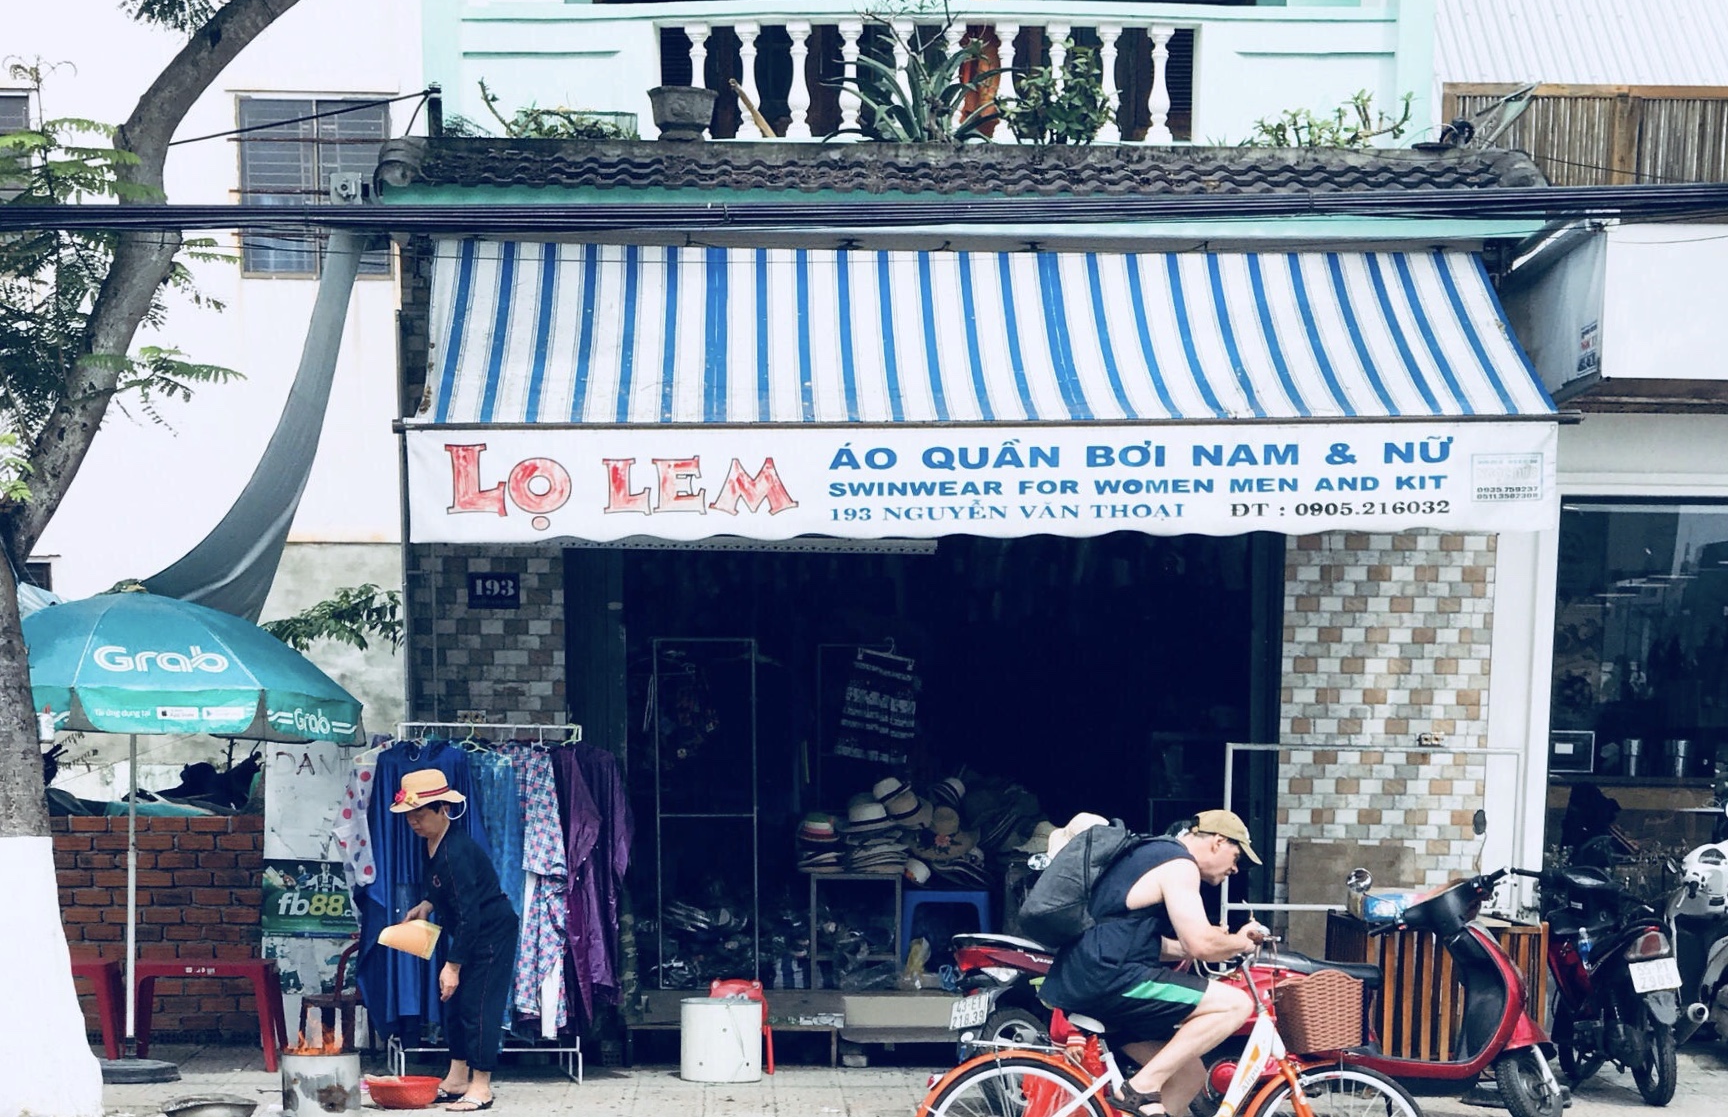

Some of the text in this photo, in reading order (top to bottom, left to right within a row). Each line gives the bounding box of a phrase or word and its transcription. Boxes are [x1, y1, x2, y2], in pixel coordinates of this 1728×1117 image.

[829, 435, 1455, 472] ÁO QUẦN BƠI NAM & NỮ
[601, 454, 800, 516] LEM
[828, 474, 1449, 498] SWINWEAR FOR WOMEN MEN AND KIT
[830, 498, 1185, 522] 193 NGUYỄN VĂN THOẠI
[1230, 502, 1271, 518] ĐT
[1294, 499, 1450, 517] 0905.216032
[475, 578, 515, 596] 193
[93, 645, 230, 674] Grab
[293, 707, 331, 735] Grab
[277, 892, 354, 918] fb88.c
